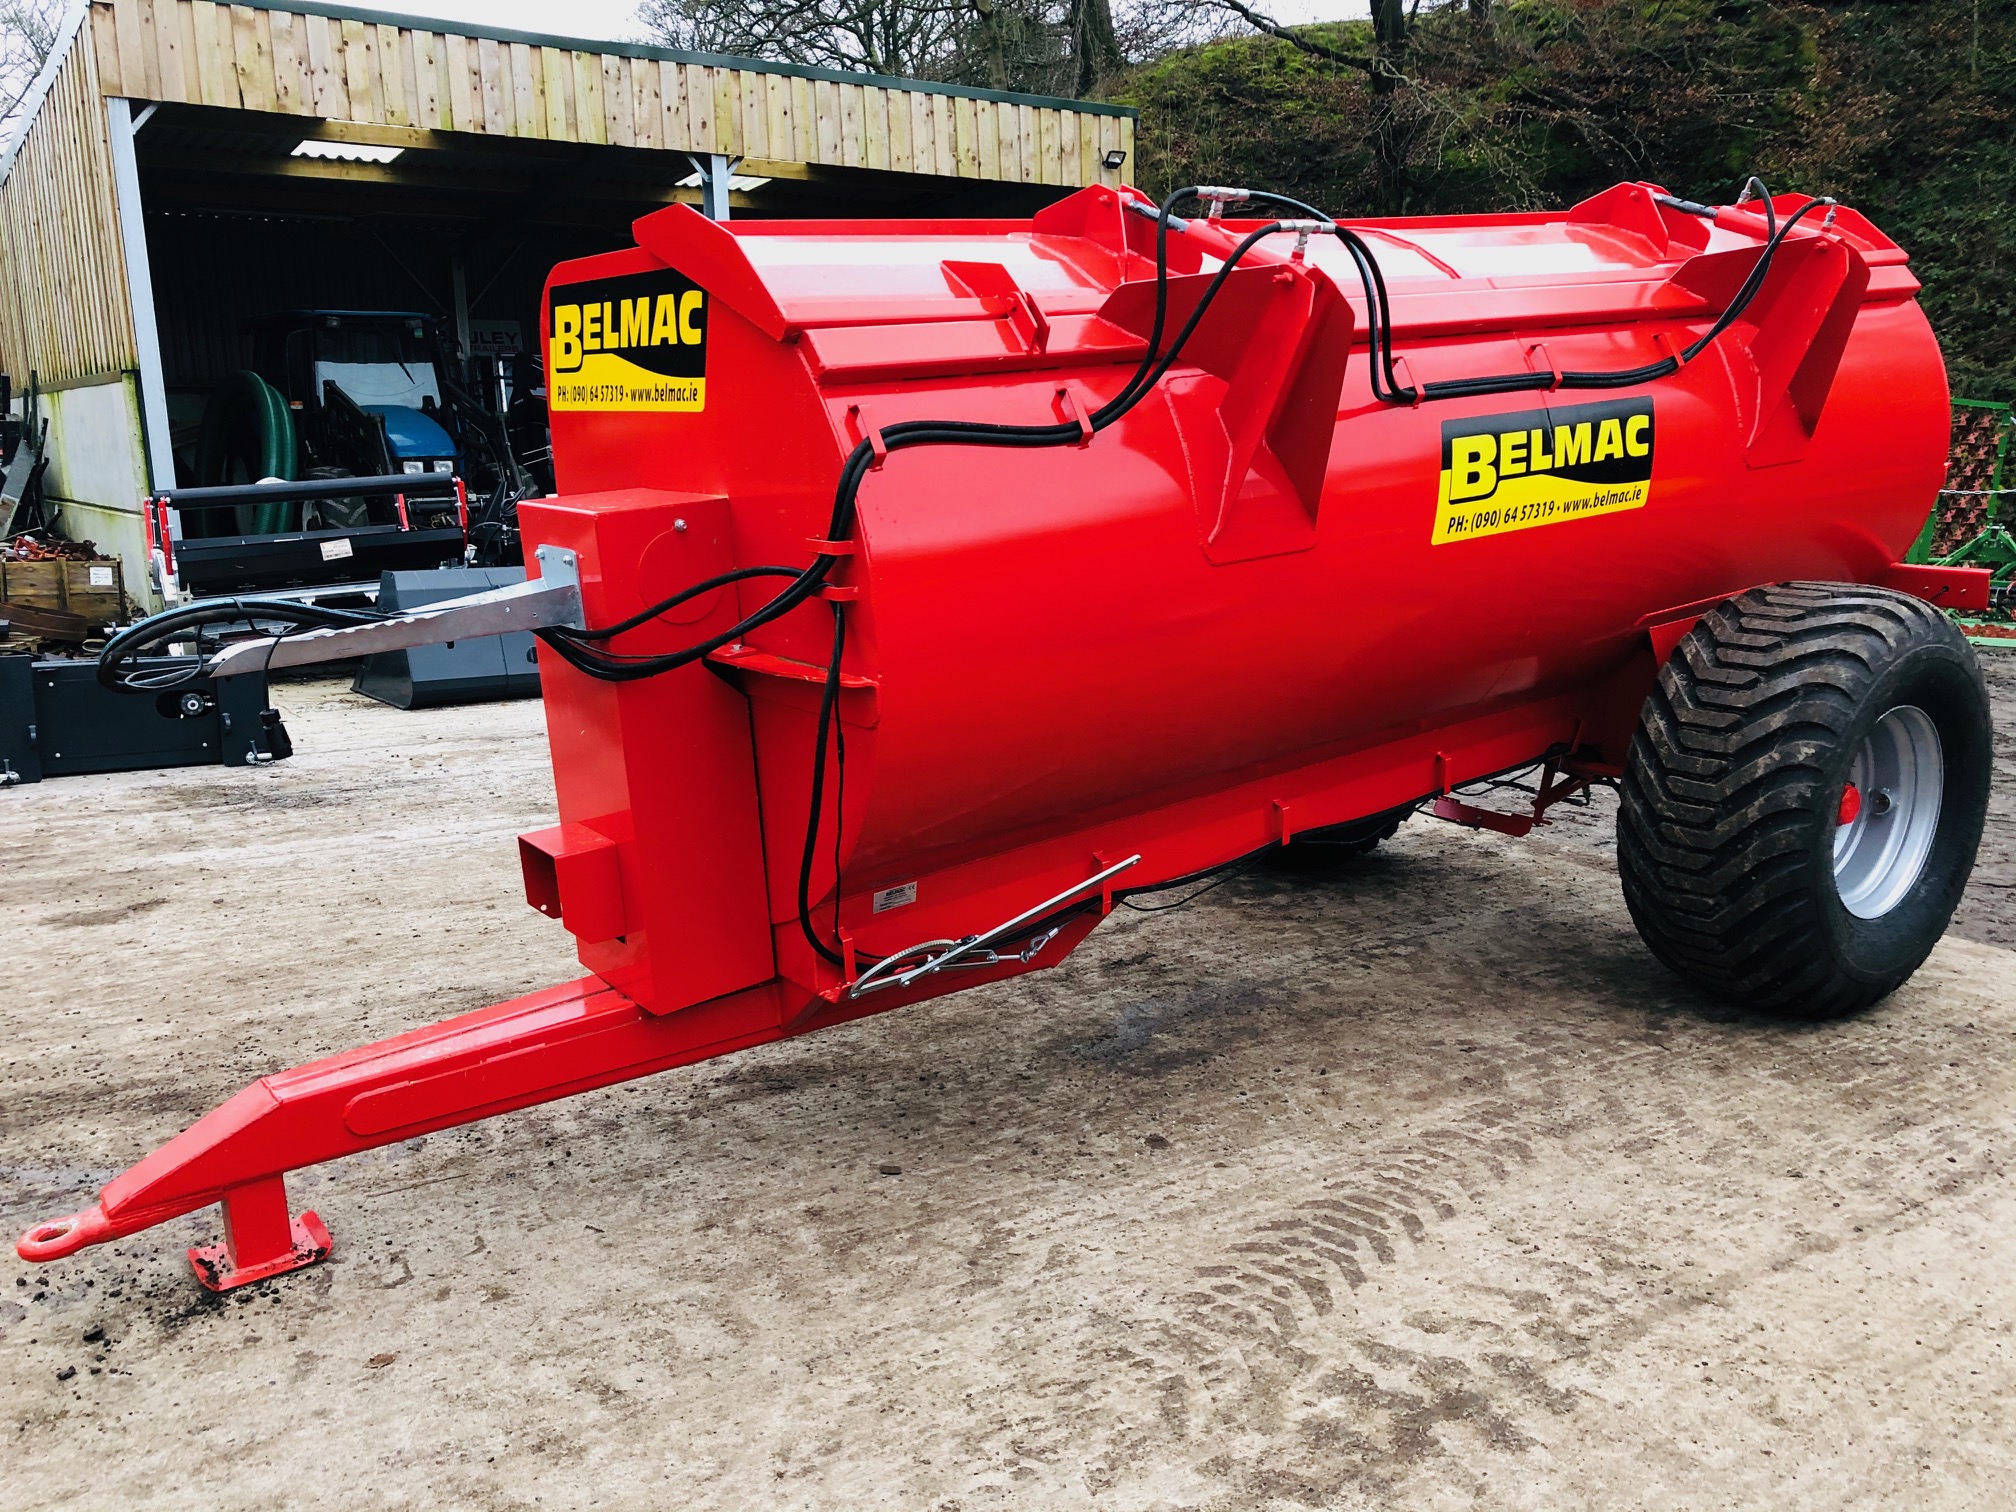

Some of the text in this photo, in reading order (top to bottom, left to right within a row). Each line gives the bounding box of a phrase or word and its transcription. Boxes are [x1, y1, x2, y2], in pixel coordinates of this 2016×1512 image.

[554, 290, 703, 371] BELMAC
[557, 382, 698, 405] PH: (090) 64 57319 www.belmac.ie
[1449, 414, 1650, 502] BELMAC
[1447, 485, 1642, 534] PH: (090) 64 57319 www.belmac.ie
